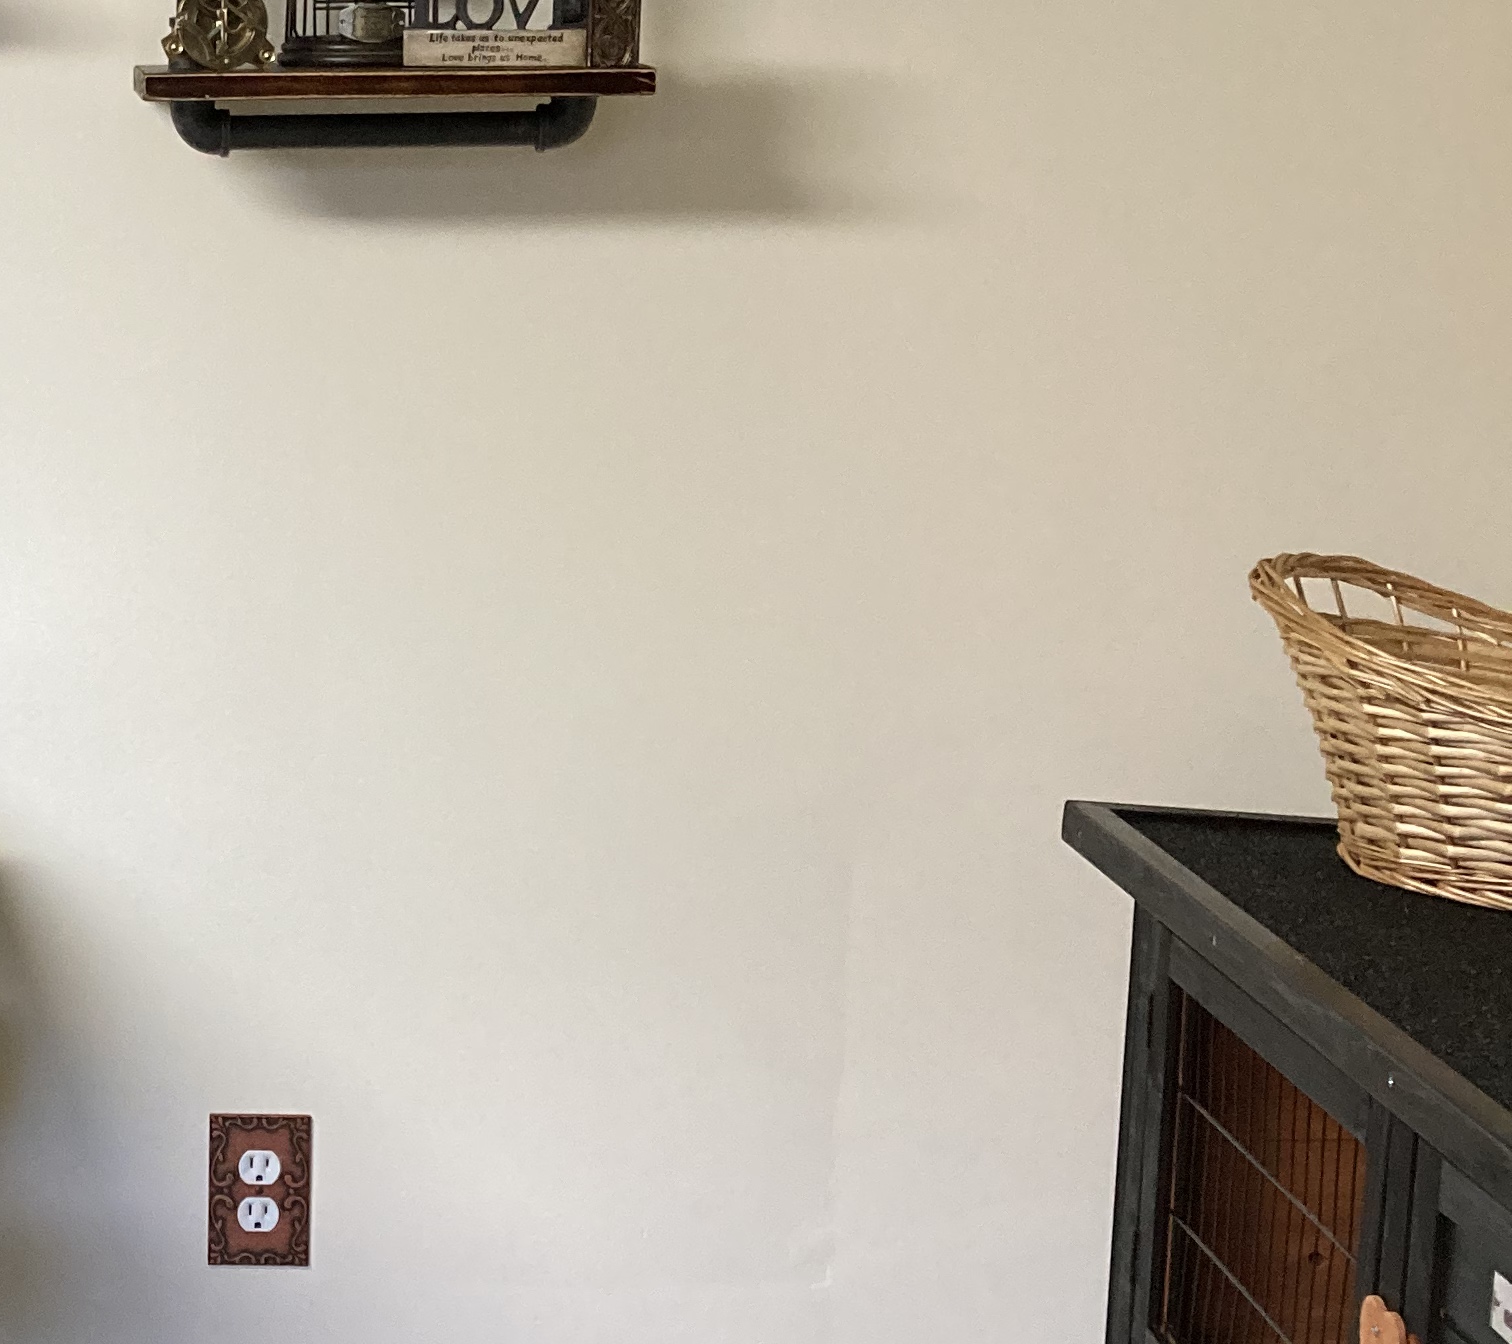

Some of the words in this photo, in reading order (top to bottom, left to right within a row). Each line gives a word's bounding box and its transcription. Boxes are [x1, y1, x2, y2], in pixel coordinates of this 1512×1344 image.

[428, 32, 449, 44] Life
[451, 33, 476, 44] takes
[478, 35, 490, 43] us
[493, 34, 505, 43] to
[507, 33, 564, 45] unexpected
[441, 53, 465, 62] Love
[467, 52, 497, 64] brings
[499, 54, 511, 62] us
